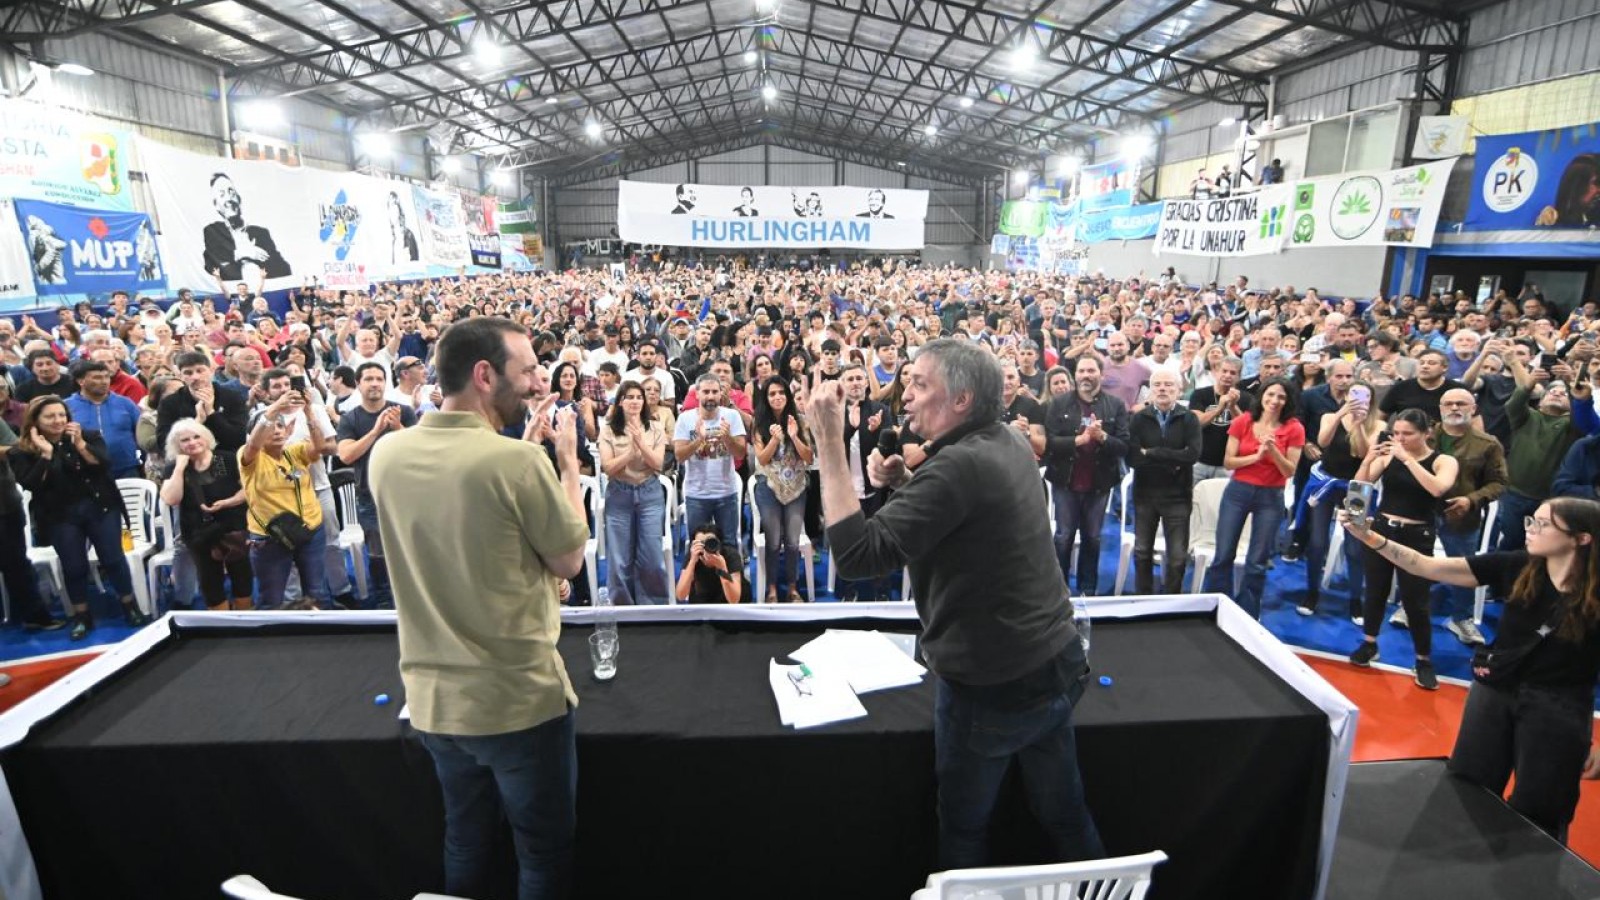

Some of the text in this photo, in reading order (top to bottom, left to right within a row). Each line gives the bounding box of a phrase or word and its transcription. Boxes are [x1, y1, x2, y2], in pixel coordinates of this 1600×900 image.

[1493, 169, 1526, 195] PK
[1166, 197, 1257, 222] GRACIAS CRISTINA
[691, 220, 871, 242] HURLINGHAM
[1163, 228, 1246, 252] POR LA UNAHUR
[70, 238, 134, 269] MUP
